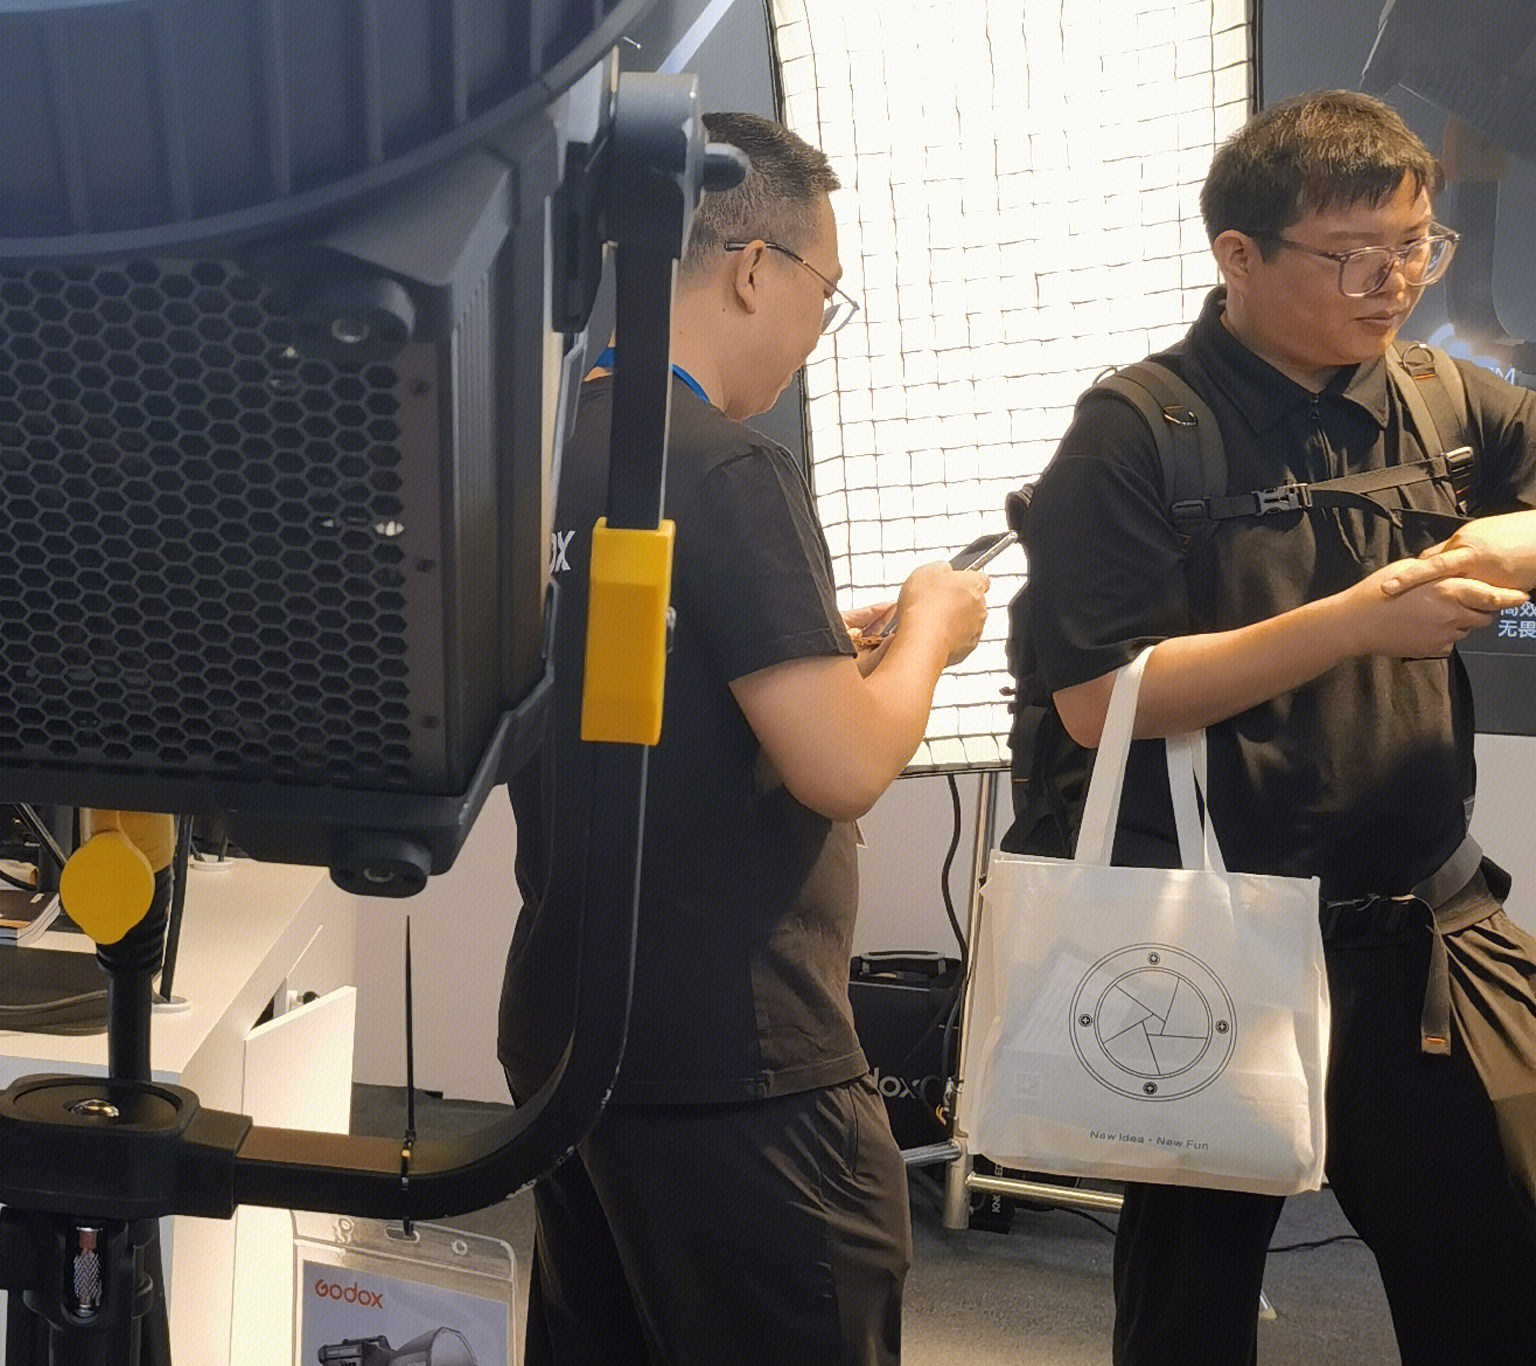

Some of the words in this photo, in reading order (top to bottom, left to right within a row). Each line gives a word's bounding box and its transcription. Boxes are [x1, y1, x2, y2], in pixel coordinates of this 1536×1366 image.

[1119, 1132, 1145, 1144] Idea
[1186, 1139, 1209, 1150] Fun
[314, 1277, 384, 1309] Godox
